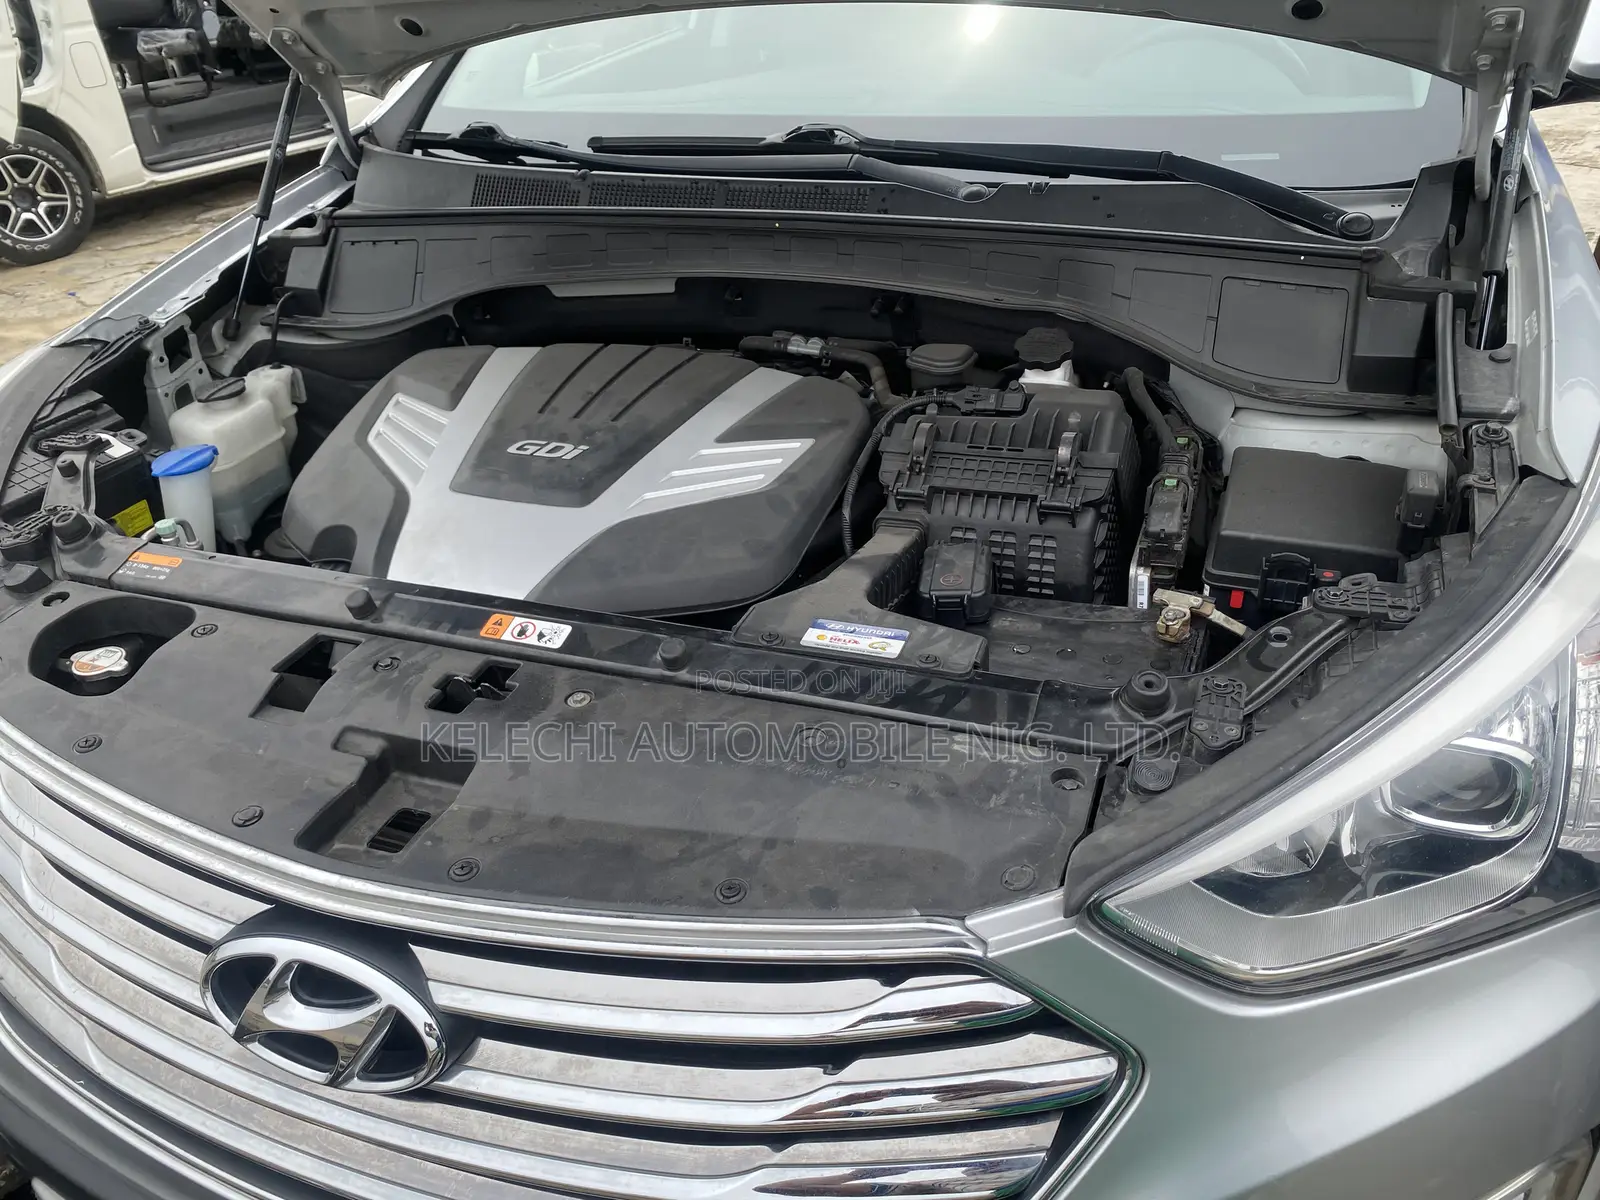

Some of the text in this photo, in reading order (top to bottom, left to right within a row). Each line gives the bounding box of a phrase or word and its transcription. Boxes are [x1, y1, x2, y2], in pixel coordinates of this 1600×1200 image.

[28, 146, 65, 169] TOYO
[506, 440, 590, 460] GDi
[846, 624, 896, 638] HYUNDAI
